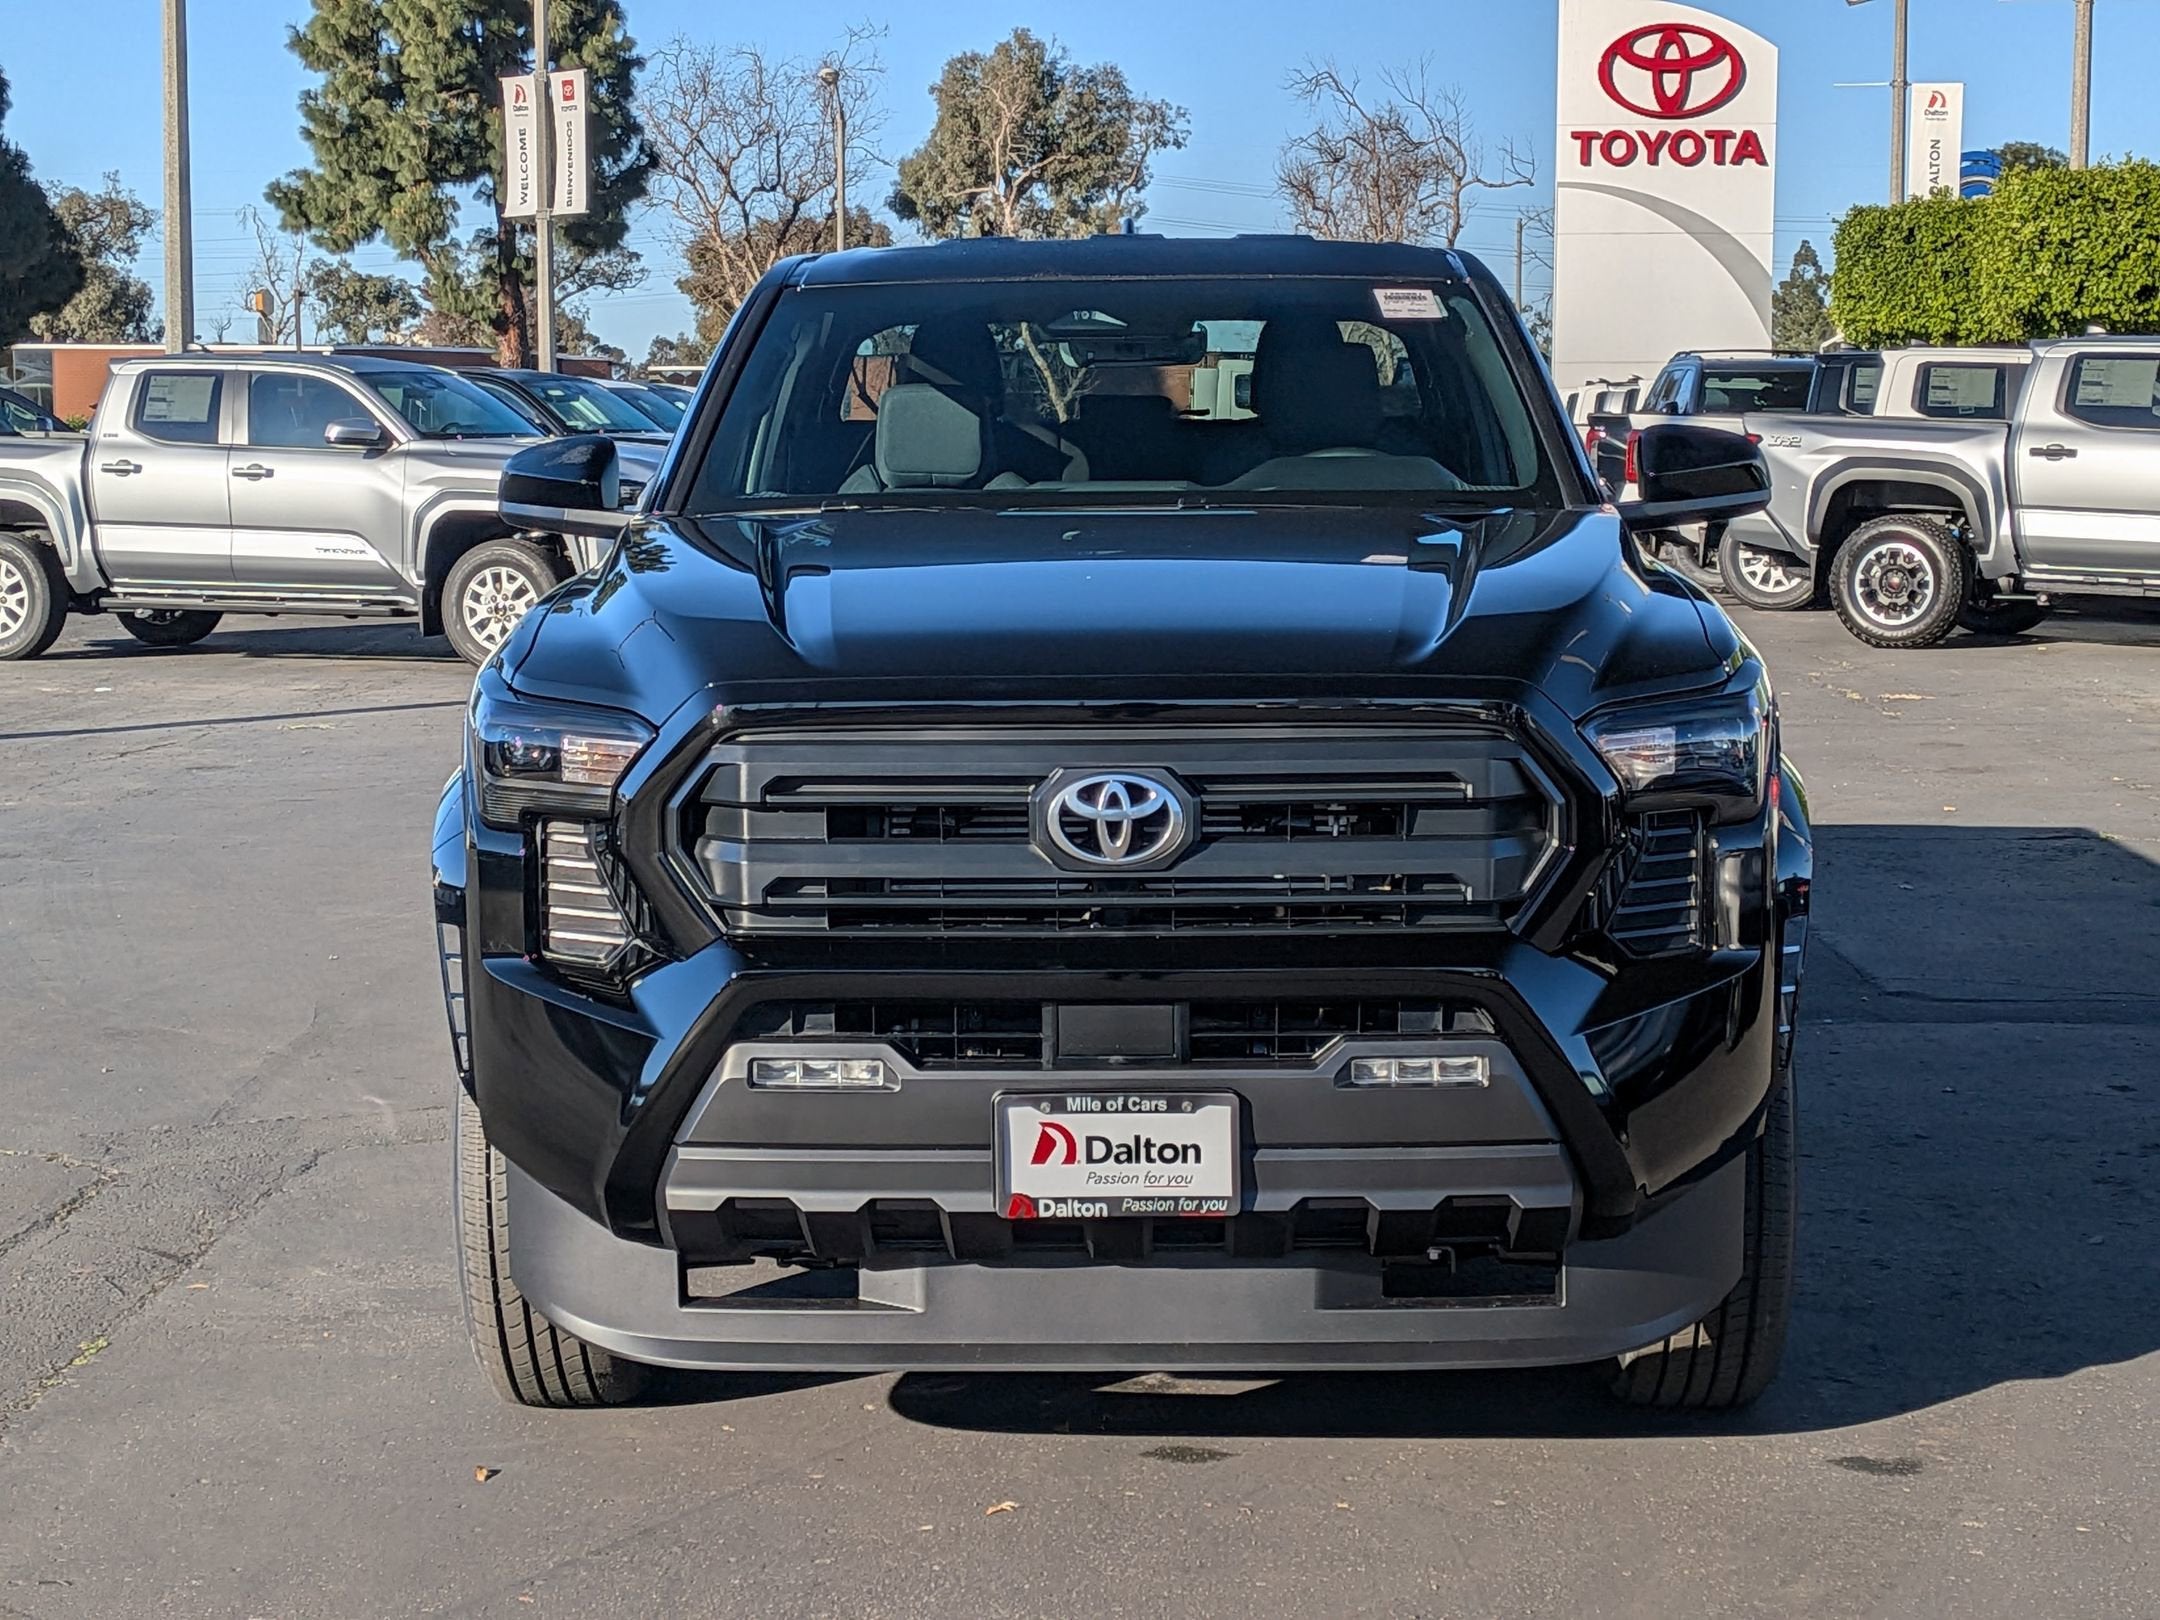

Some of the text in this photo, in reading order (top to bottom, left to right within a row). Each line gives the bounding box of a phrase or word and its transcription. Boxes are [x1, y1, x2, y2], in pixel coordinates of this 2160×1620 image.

[1571, 129, 1769, 167] TOYOTA
[519, 128, 529, 205] WELCOME
[566, 121, 574, 207] BIENVENIDOS
[1929, 139, 1940, 196] DALTON
[1066, 1096, 1168, 1112] Mile of Cars
[1085, 1134, 1202, 1164] Dalton
[1086, 1170, 1193, 1185] Passion for you
[1038, 1199, 1108, 1218] Dalton
[1121, 1198, 1228, 1214] Passion for you
